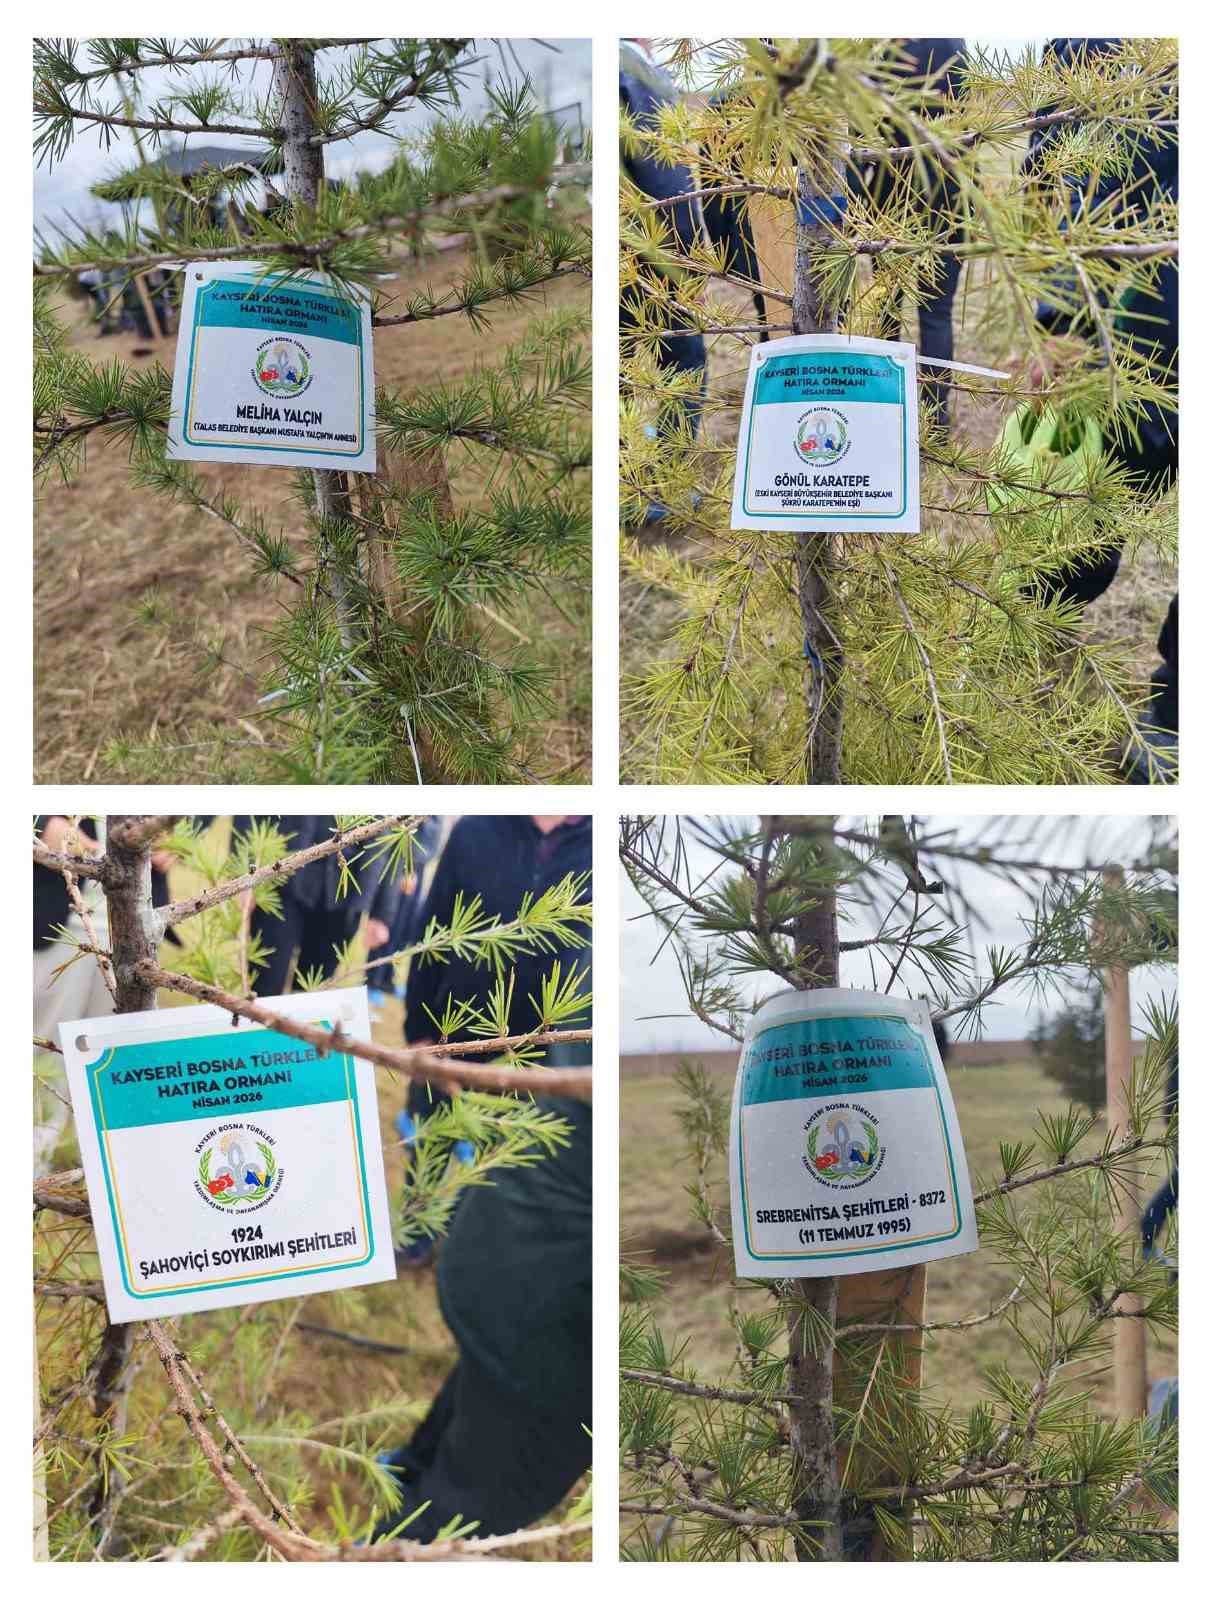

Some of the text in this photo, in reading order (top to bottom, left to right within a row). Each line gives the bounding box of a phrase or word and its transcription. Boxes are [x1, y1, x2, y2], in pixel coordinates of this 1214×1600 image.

[240, 303, 328, 325] HATIRA ORMANI
[802, 366, 840, 376] BOSNA
[784, 377, 866, 388] HATIRA ORMANI
[236, 403, 322, 426] MELİHA YALÇIN
[194, 422, 217, 431] (TALAS
[217, 423, 249, 433] BELEDİYE
[249, 426, 277, 436] BAŞKANI
[277, 428, 305, 438] MUSTAFA
[774, 472, 870, 487] GÖNÜL KARATEPE
[770, 489, 793, 497] KAYSERİ
[833, 489, 864, 498] BELEDİYE
[864, 490, 893, 499] BAŞKANI
[797, 1041, 855, 1057] BOSNA
[111, 1061, 182, 1085] KAYSERİ
[187, 1057, 247, 1076] BOSNA
[774, 1055, 892, 1077] HATIRA ORMANI
[157, 1070, 293, 1098] HATIRA ORMANI
[803, 1076, 838, 1088] NİSAN
[192, 1091, 263, 1109] NİSAN 2026
[825, 1103, 850, 1112] BOSNA
[194, 1123, 276, 1154] KAYSERİ BOSNA TÜRKLERİ
[756, 1204, 840, 1223] SREBRENİTSA
[843, 1193, 910, 1221] ŞEHİTLERİ
[919, 1190, 946, 1207] 8372
[231, 1225, 263, 1244] 1924
[799, 1217, 911, 1245] (11 TEMMUZ 1995)
[139, 1226, 357, 1279] ŞAHOVİÇİ SOYKIRIMI ŞEHİTLERİ
